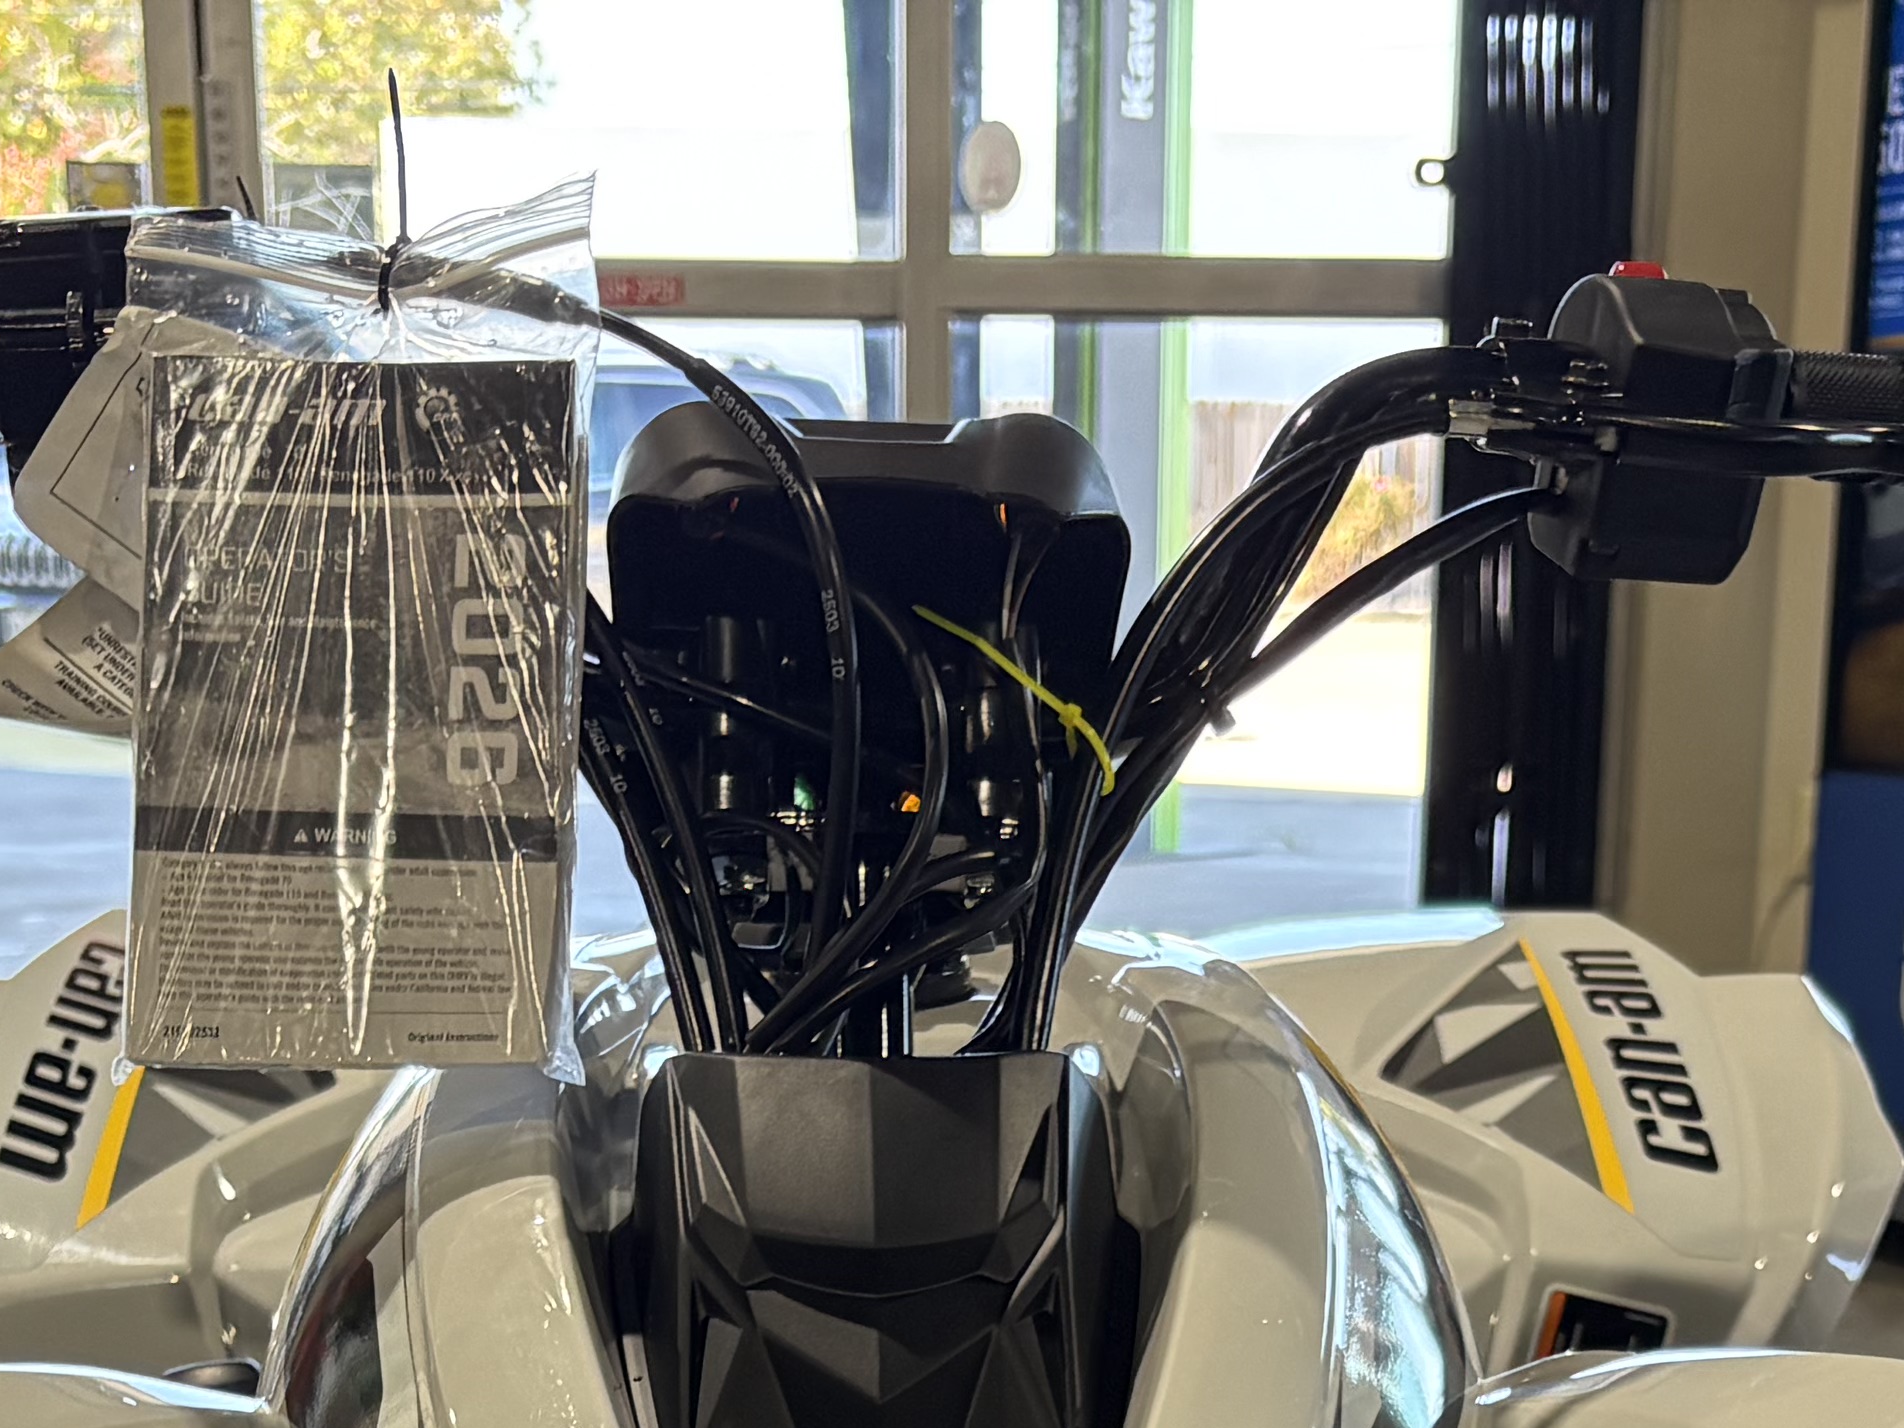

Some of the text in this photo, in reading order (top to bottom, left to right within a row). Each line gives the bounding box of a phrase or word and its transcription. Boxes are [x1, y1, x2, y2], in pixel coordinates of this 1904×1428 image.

[184, 545, 349, 573] OPERAOR'S
[445, 533, 527, 786] 2026
[314, 827, 397, 845] WARNIG
[1561, 950, 1719, 1173] can-am
